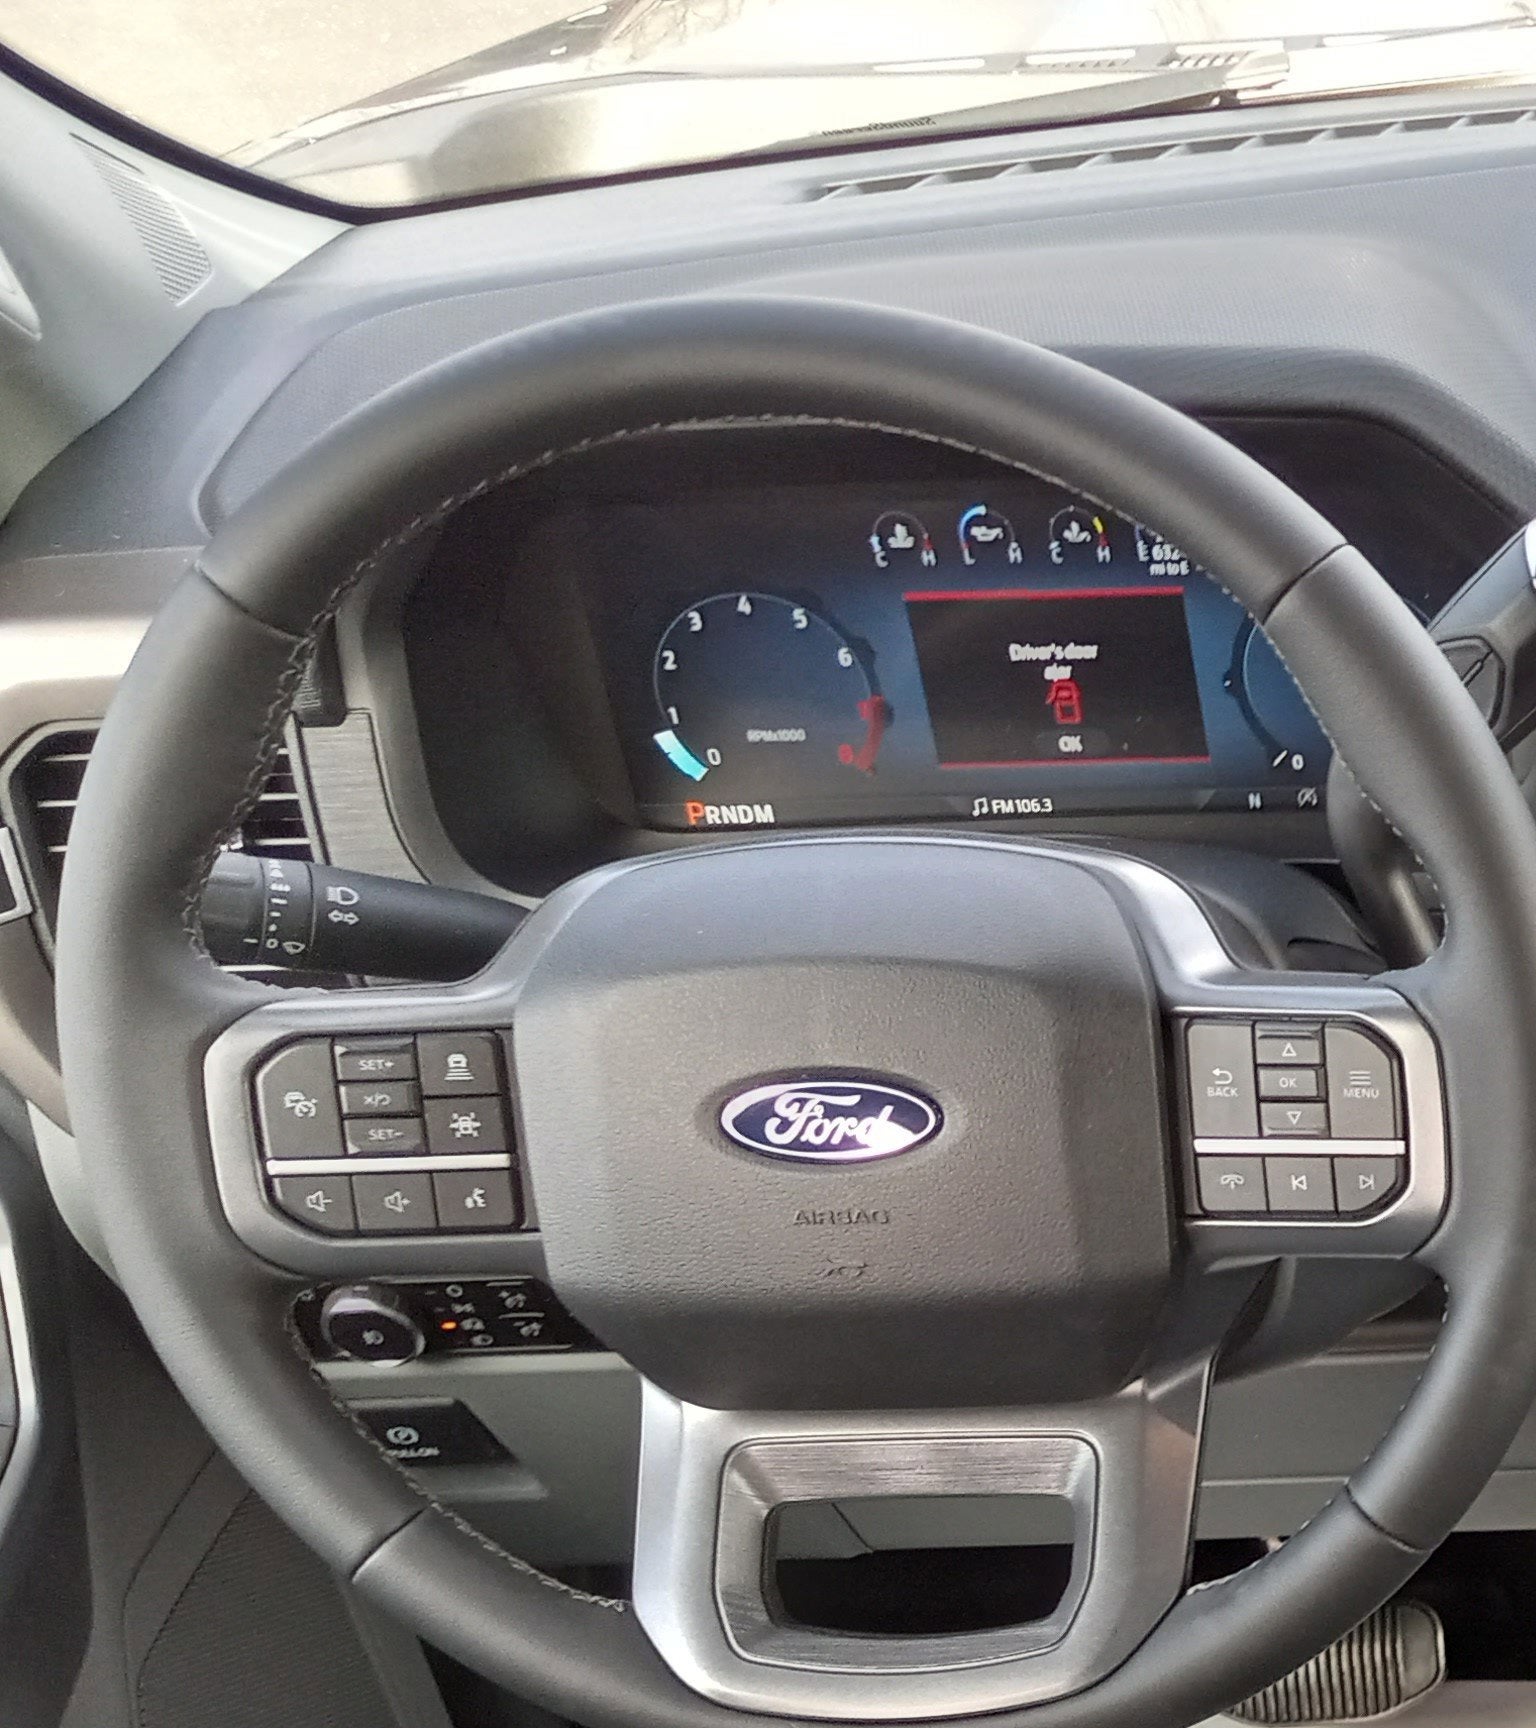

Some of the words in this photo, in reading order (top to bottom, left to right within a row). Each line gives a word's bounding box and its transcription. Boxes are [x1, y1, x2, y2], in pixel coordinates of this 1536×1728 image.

[922, 550, 937, 566] H
[964, 548, 976, 565] L
[1097, 546, 1112, 563] H
[736, 595, 752, 615] 4
[688, 611, 702, 631] 3
[793, 608, 808, 629] 5
[662, 650, 678, 670] 2
[838, 647, 853, 667] 6
[668, 706, 679, 725] 1
[706, 748, 721, 765] 0
[1291, 754, 1304, 770] 0
[1279, 1077, 1297, 1088] OK
[1206, 1087, 1239, 1099] BACK
[1343, 1087, 1380, 1099] MENU
[765, 1092, 894, 1145] Ford
[793, 1208, 890, 1227] AIRBAG
